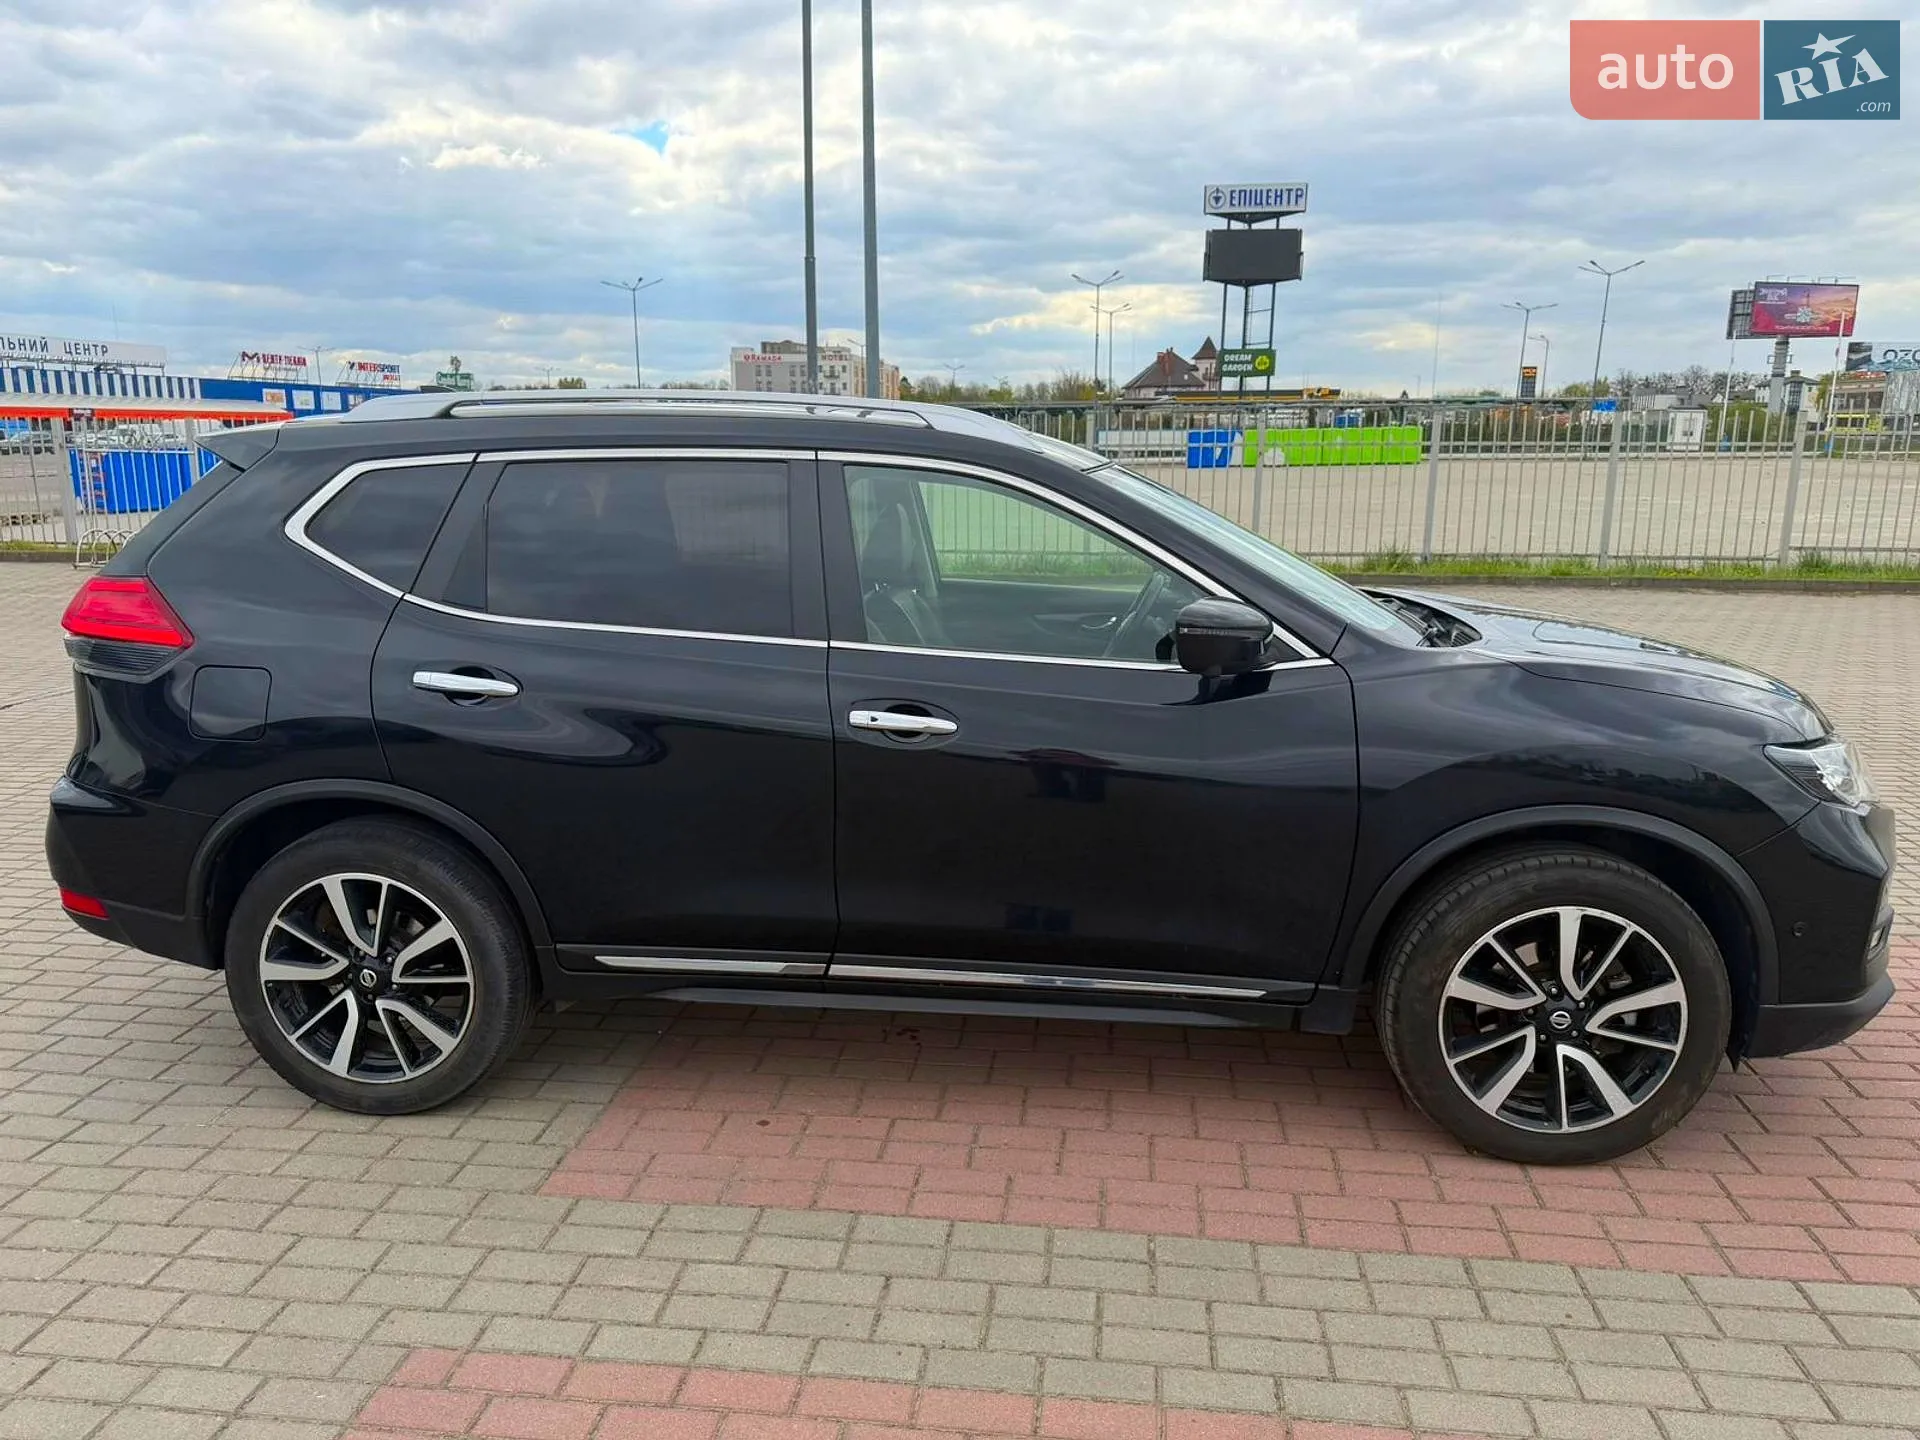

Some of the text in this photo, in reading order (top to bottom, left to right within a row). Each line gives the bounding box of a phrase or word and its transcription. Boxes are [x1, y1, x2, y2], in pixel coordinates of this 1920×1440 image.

[1230, 188, 1304, 207] ЕПІЦЕНТР
[63, 341, 108, 356] ЦЕНТР
[821, 354, 848, 362] HOTEL
[1222, 363, 1253, 371] GARDEN
